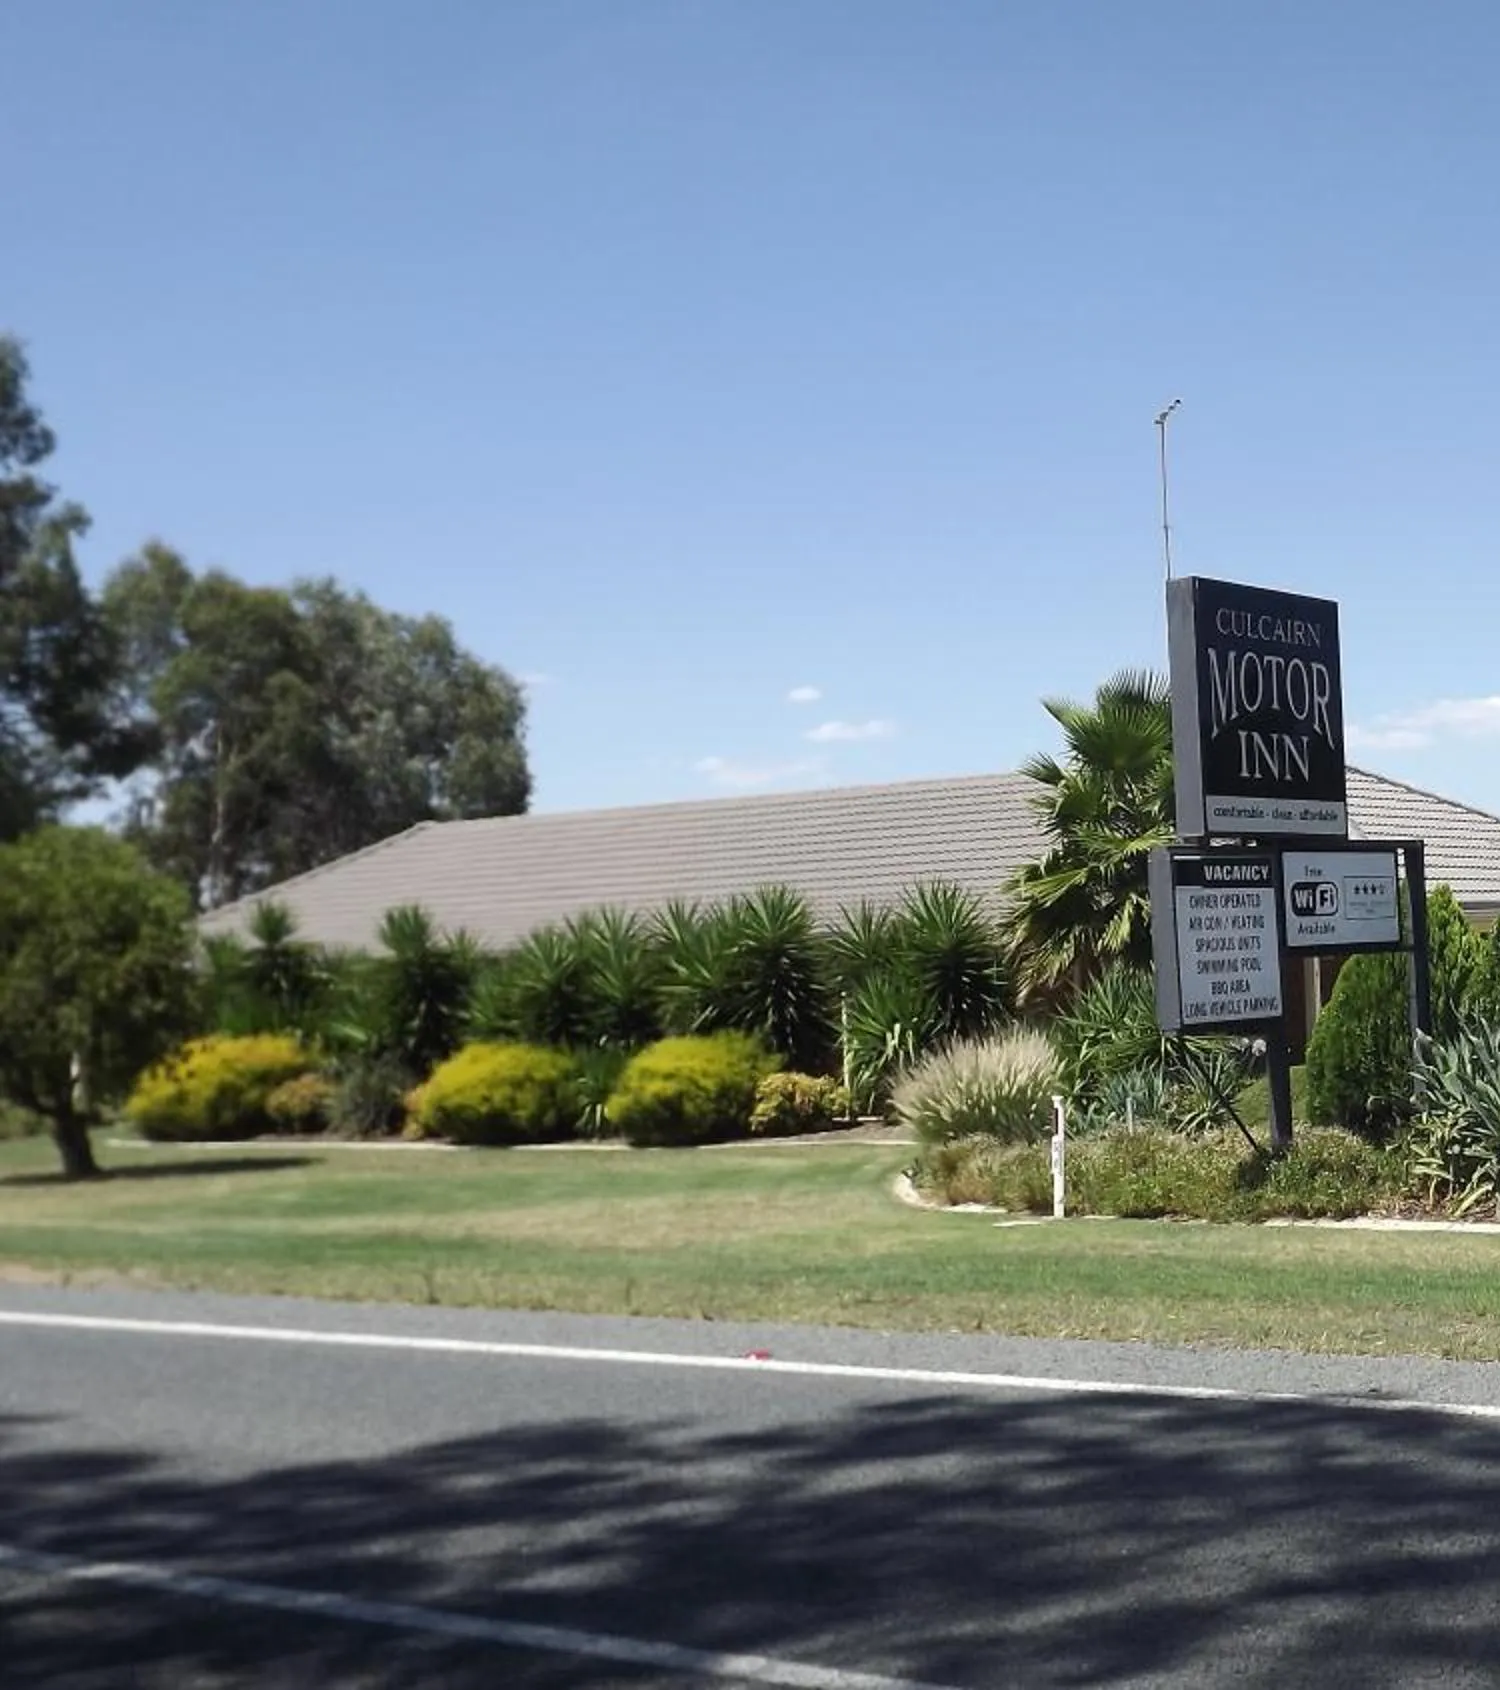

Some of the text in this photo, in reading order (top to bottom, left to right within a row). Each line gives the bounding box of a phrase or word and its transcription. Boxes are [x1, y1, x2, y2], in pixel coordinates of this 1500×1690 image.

[1216, 608, 1321, 647] CULCAIRN
[1207, 648, 1335, 749] MOTOR
[1238, 730, 1309, 782] INN
[1203, 865, 1269, 881] VACANCY
[1189, 893, 1261, 908] OWNER OPERATED
[1189, 916, 1202, 930] AIR
[1231, 915, 1264, 929] HEATING
[1297, 921, 1335, 935] Available
[1195, 936, 1261, 952] SPACIOUS UNITS
[1197, 957, 1261, 974] SWIMMING POOL
[1211, 979, 1251, 995] BBQ AREA
[1185, 997, 1278, 1018] LONG VEHICLE PARKING
